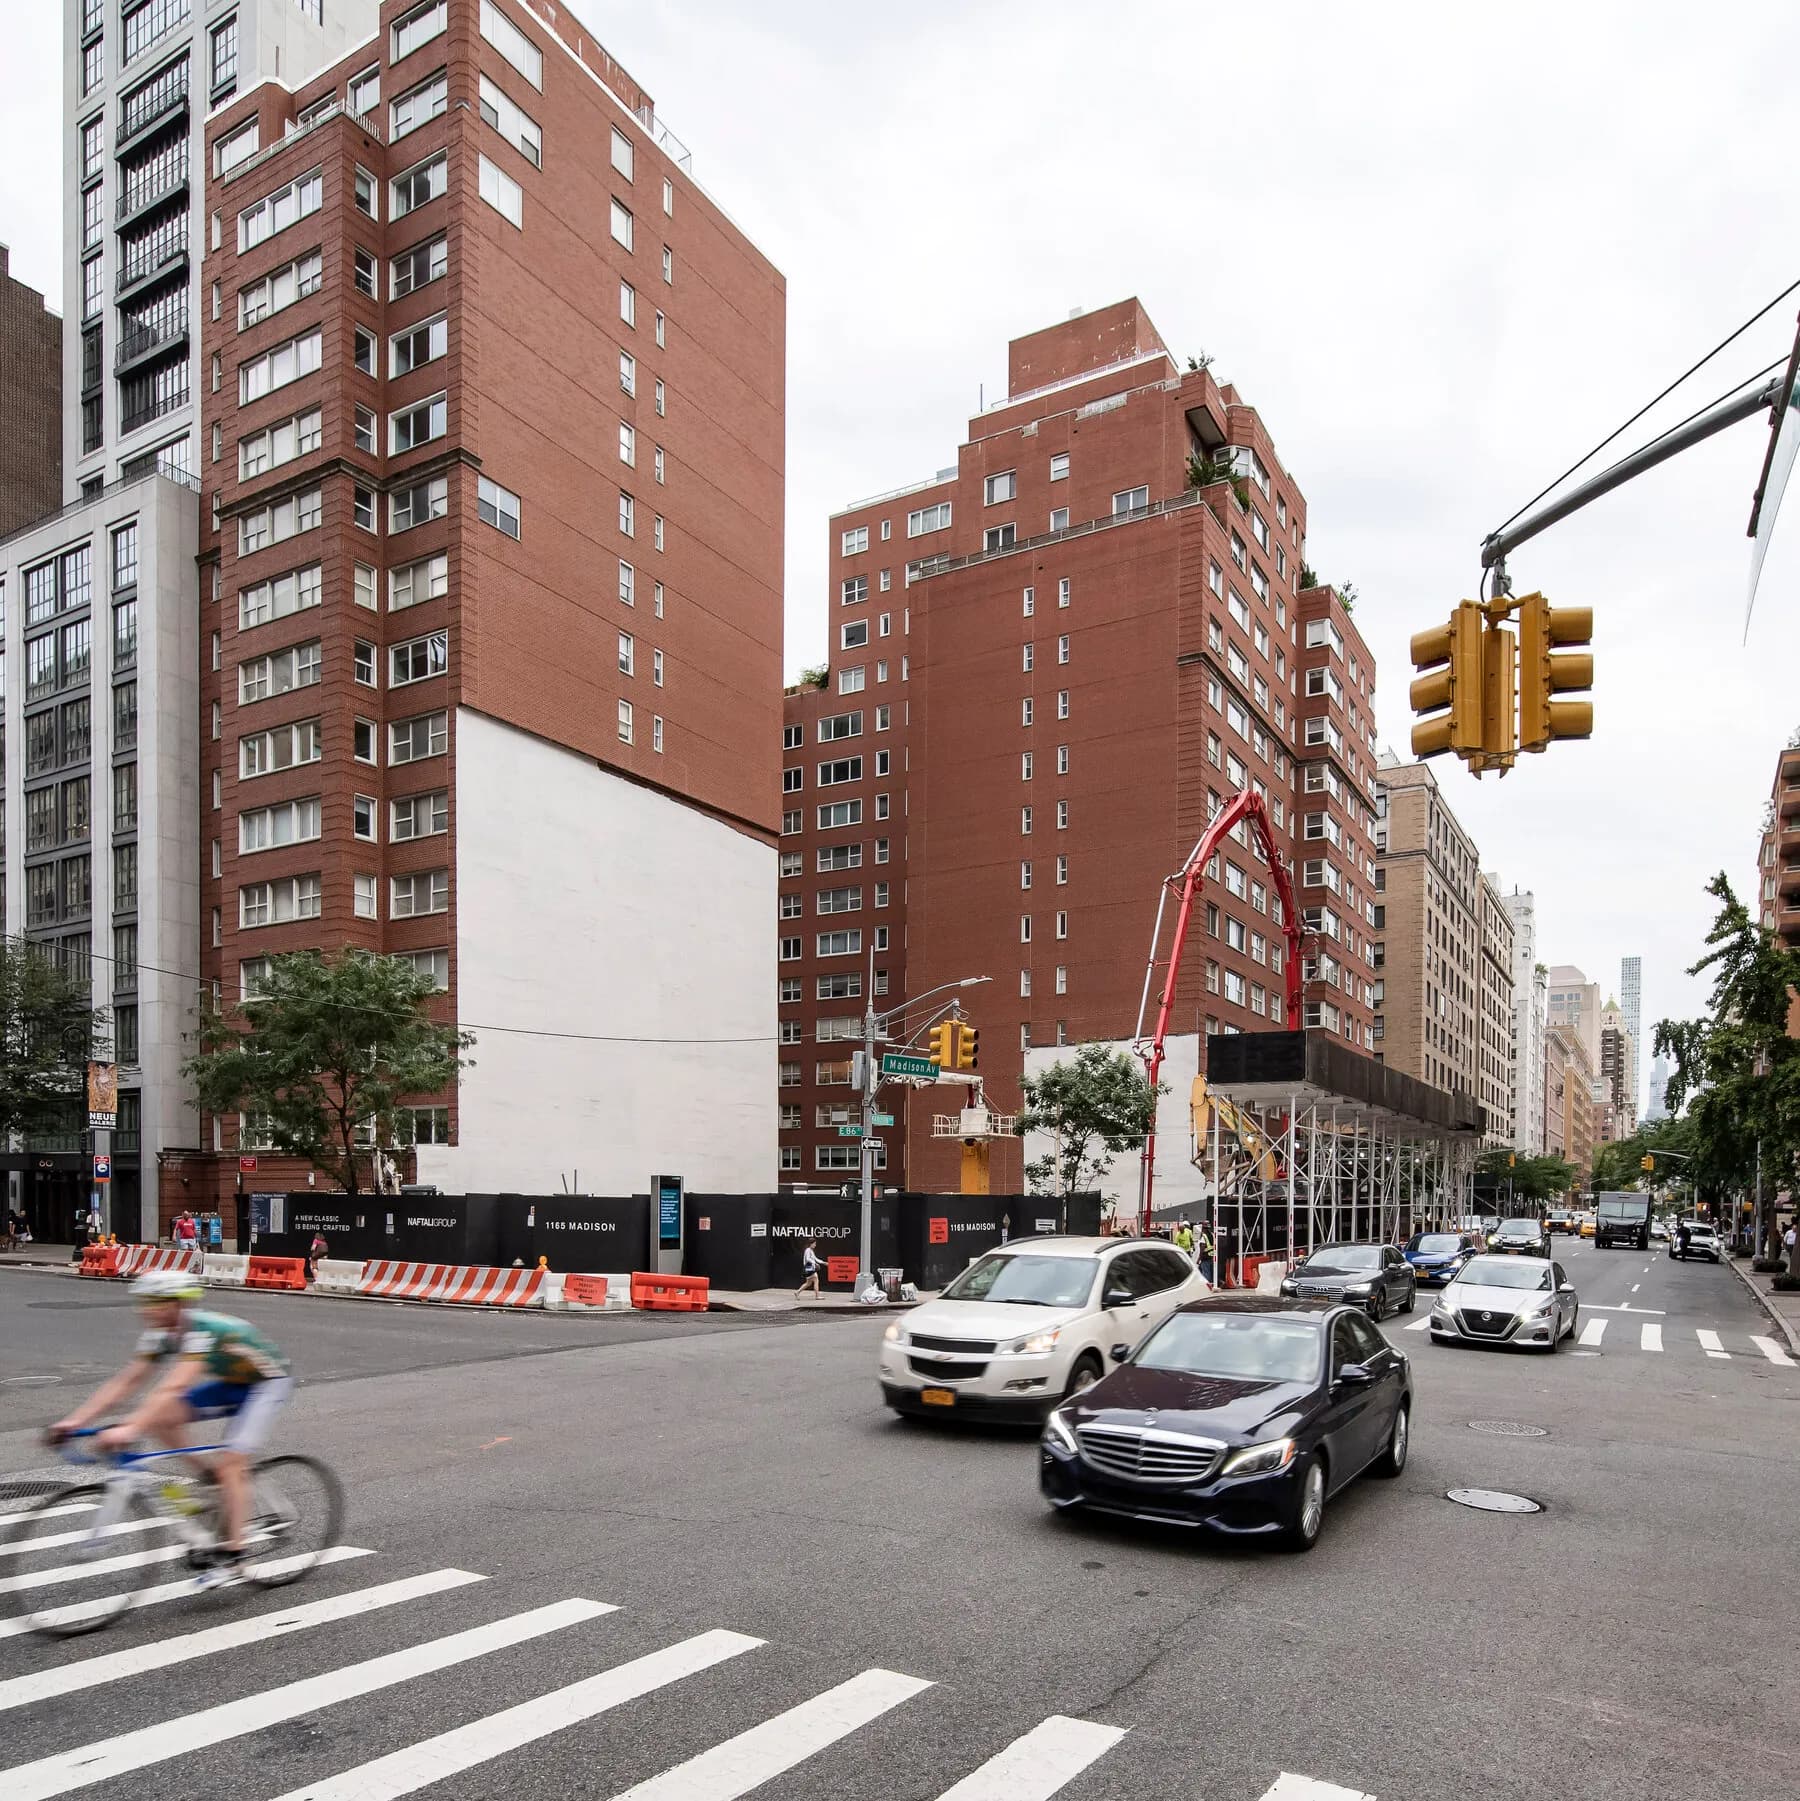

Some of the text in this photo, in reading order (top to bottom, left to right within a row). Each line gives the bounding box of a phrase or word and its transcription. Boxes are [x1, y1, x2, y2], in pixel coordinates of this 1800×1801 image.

[889, 1058, 936, 1073] Madison Av
[89, 1112, 117, 1121] NEUE
[840, 1127, 845, 1135] E
[846, 1127, 857, 1135] 86
[302, 1223, 320, 1231] BEING
[322, 1224, 351, 1232] CRAFTED
[545, 1221, 616, 1232] 1165 MADISON
[950, 1223, 965, 1232] 1165
[966, 1222, 996, 1231] MADISON
